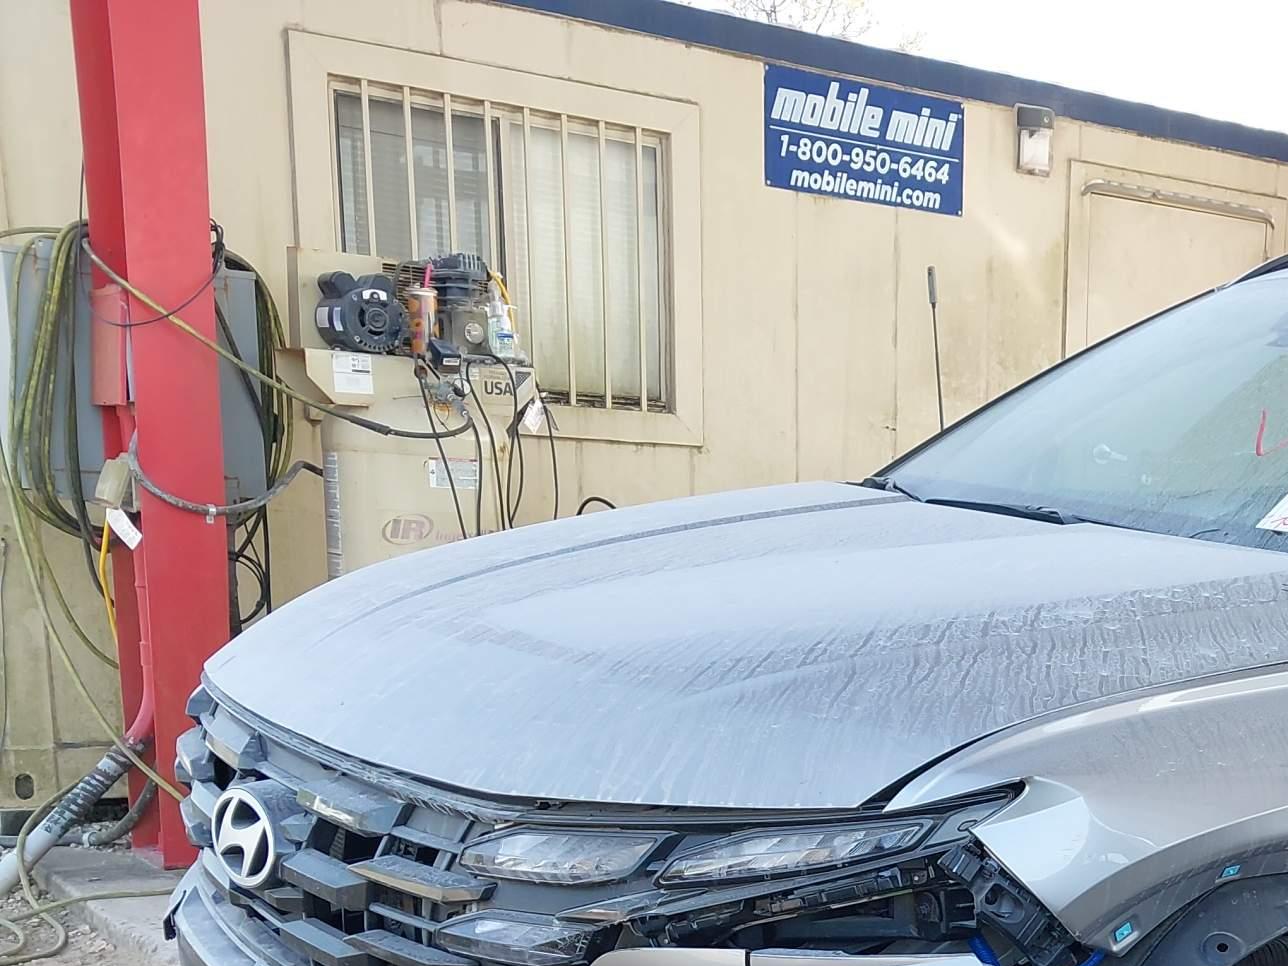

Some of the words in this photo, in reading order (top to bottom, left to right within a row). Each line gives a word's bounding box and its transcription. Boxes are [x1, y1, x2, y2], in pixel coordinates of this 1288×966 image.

[770, 81, 884, 138] mobile
[885, 107, 958, 151] mini
[780, 134, 950, 184] 1-800-950-6464
[790, 168, 941, 209] mobilemini.com
[484, 380, 514, 396] USA
